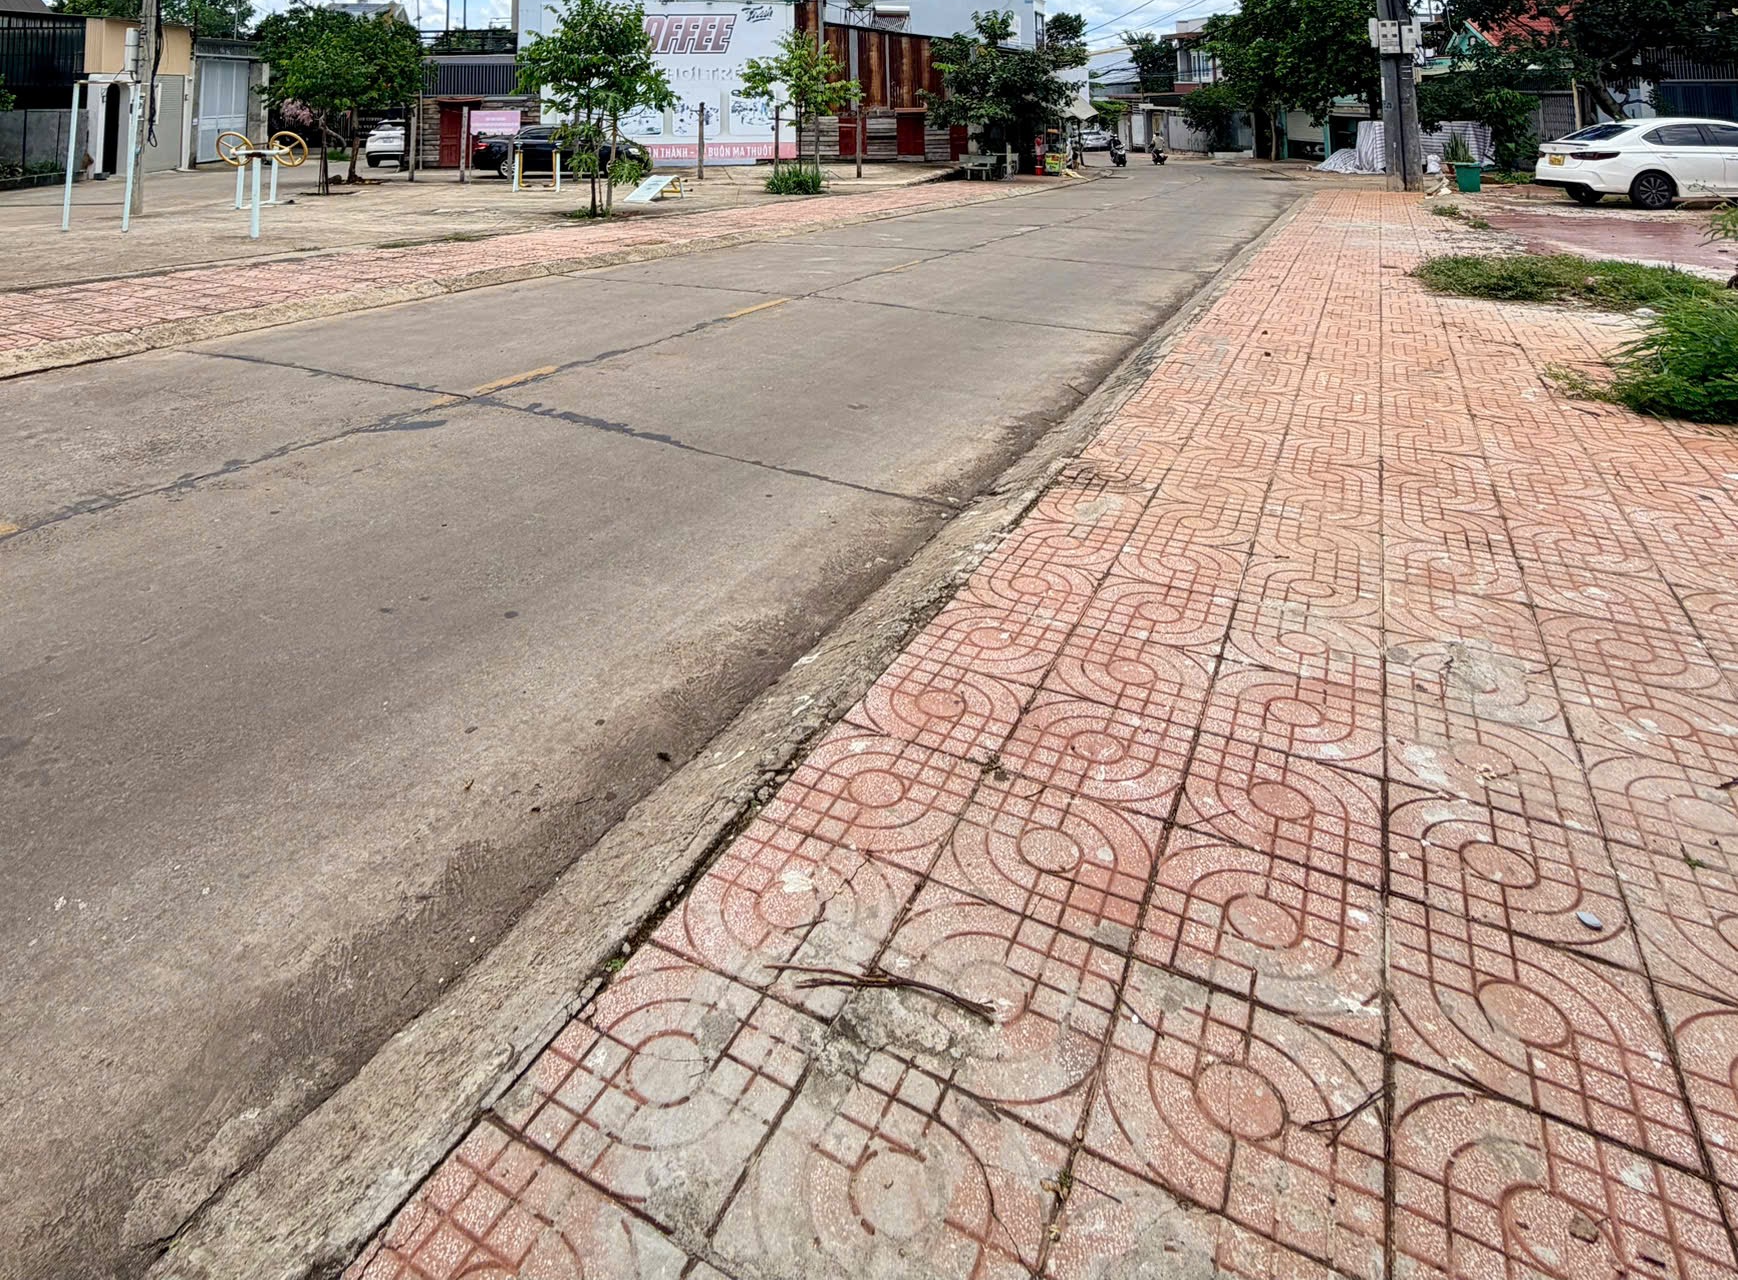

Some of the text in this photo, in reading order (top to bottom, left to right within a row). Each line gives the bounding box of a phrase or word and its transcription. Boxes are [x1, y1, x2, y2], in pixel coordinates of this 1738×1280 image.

[642, 14, 737, 54] OFFEE
[708, 144, 730, 157] BUÔN
[732, 146, 745, 157] MA
